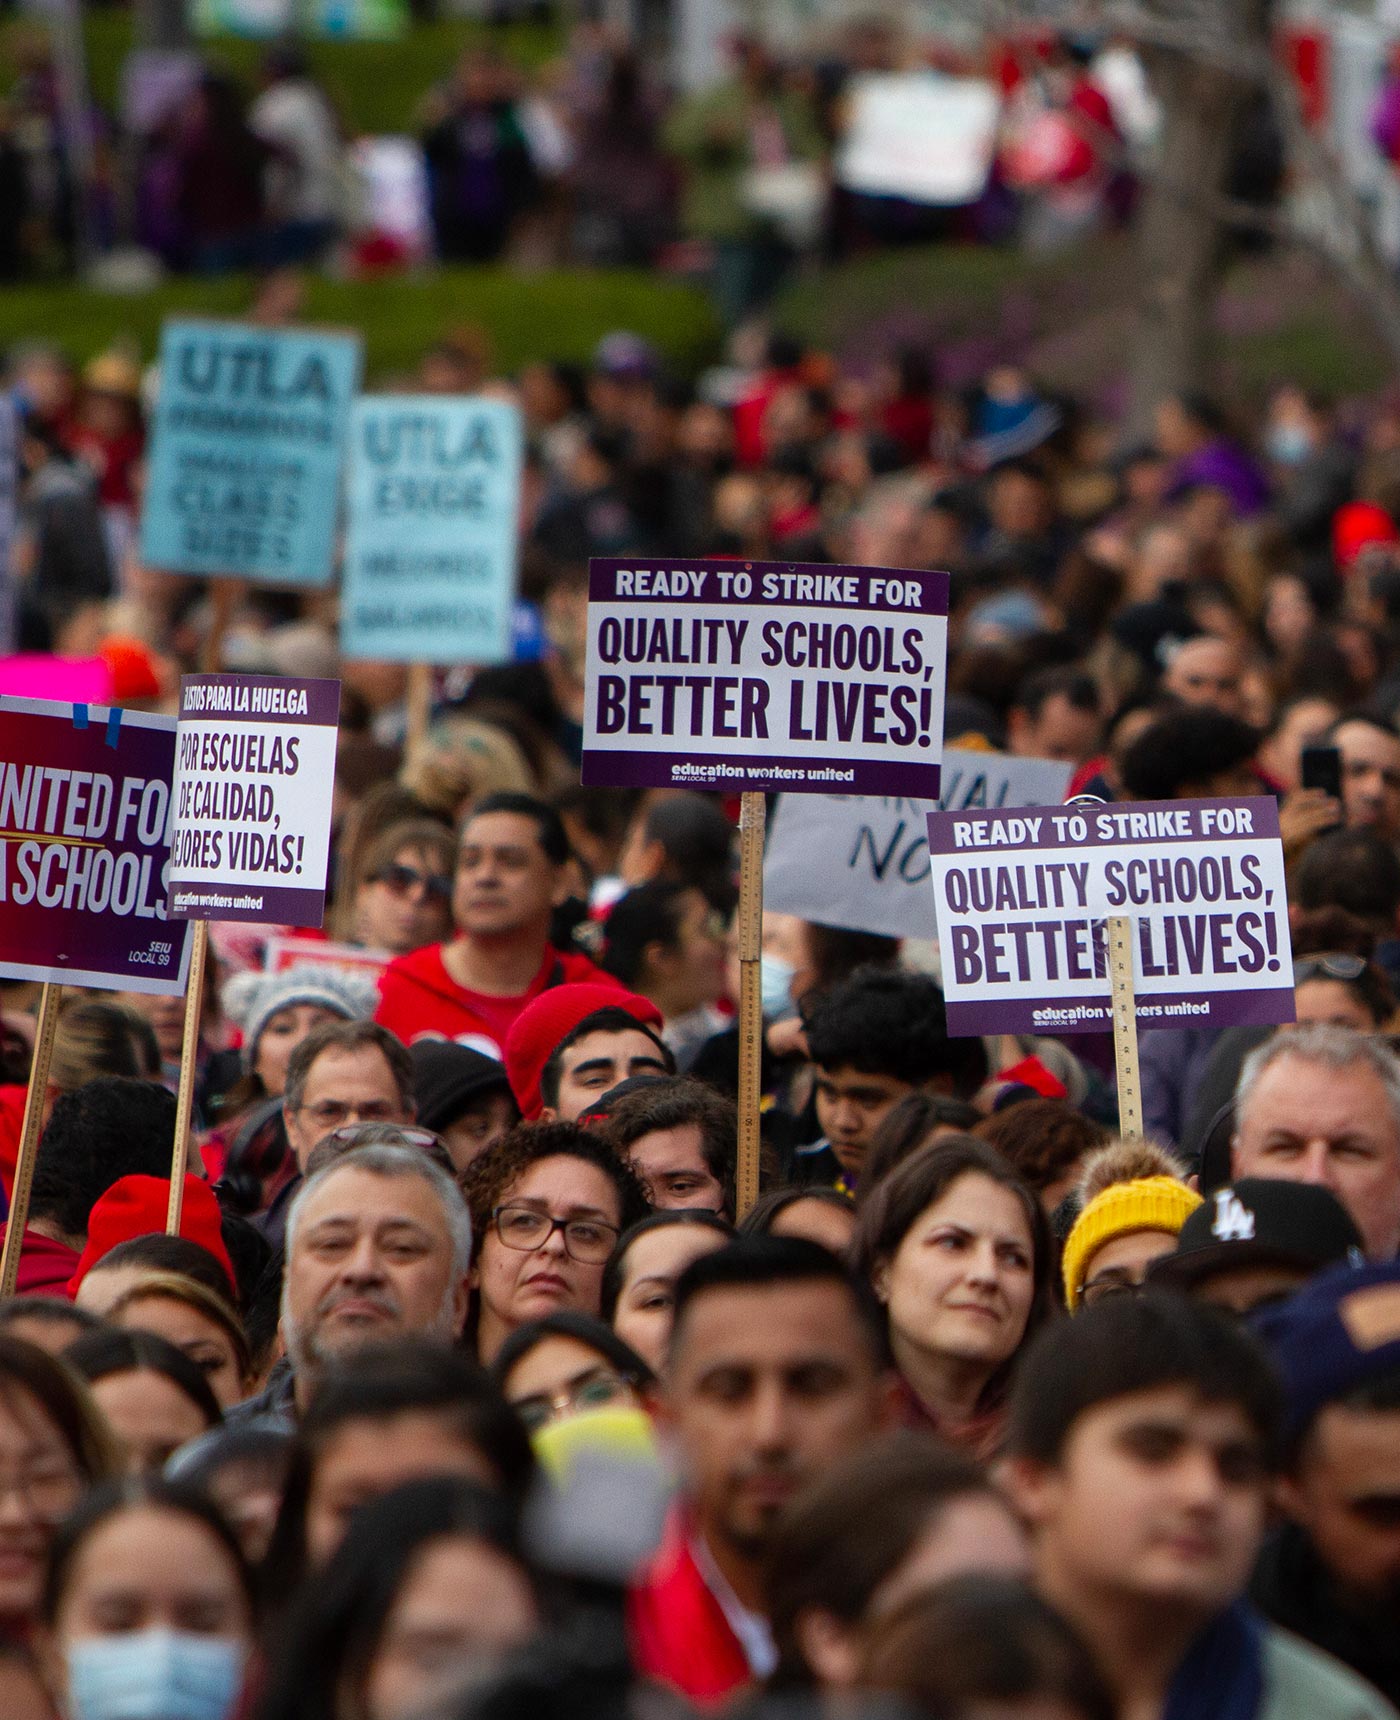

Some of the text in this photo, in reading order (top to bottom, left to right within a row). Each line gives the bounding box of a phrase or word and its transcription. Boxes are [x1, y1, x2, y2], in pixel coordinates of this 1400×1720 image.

[178, 343, 336, 402] UTLA
[363, 416, 501, 468] UTLA
[616, 570, 922, 608] READY TO STRIKE FOR
[598, 617, 934, 682] QUALITY SCHOOLS,
[206, 685, 232, 711] PARA
[234, 687, 250, 712] LA
[251, 688, 308, 715] HUELGA
[596, 675, 932, 748] BETTER LIVES!
[179, 733, 300, 776] POR ESCUELAS
[672, 763, 854, 782] education workers united
[0, 762, 114, 840] NITED
[178, 780, 281, 830] DE CALIDAD,
[952, 807, 1254, 848] READY TO STRIKE FOR
[228, 832, 304, 875] VIDAS!
[200, 893, 233, 907] workers
[233, 895, 263, 910] united
[944, 854, 1275, 915] QUALITY SCHOOLS,
[128, 951, 170, 966] LOCAL 99
[149, 941, 172, 953] SEIU
[1139, 911, 1282, 978] LIVES!
[1032, 1005, 1103, 1020] education
[1165, 1001, 1210, 1015] united
[1212, 1188, 1256, 1241] LA
